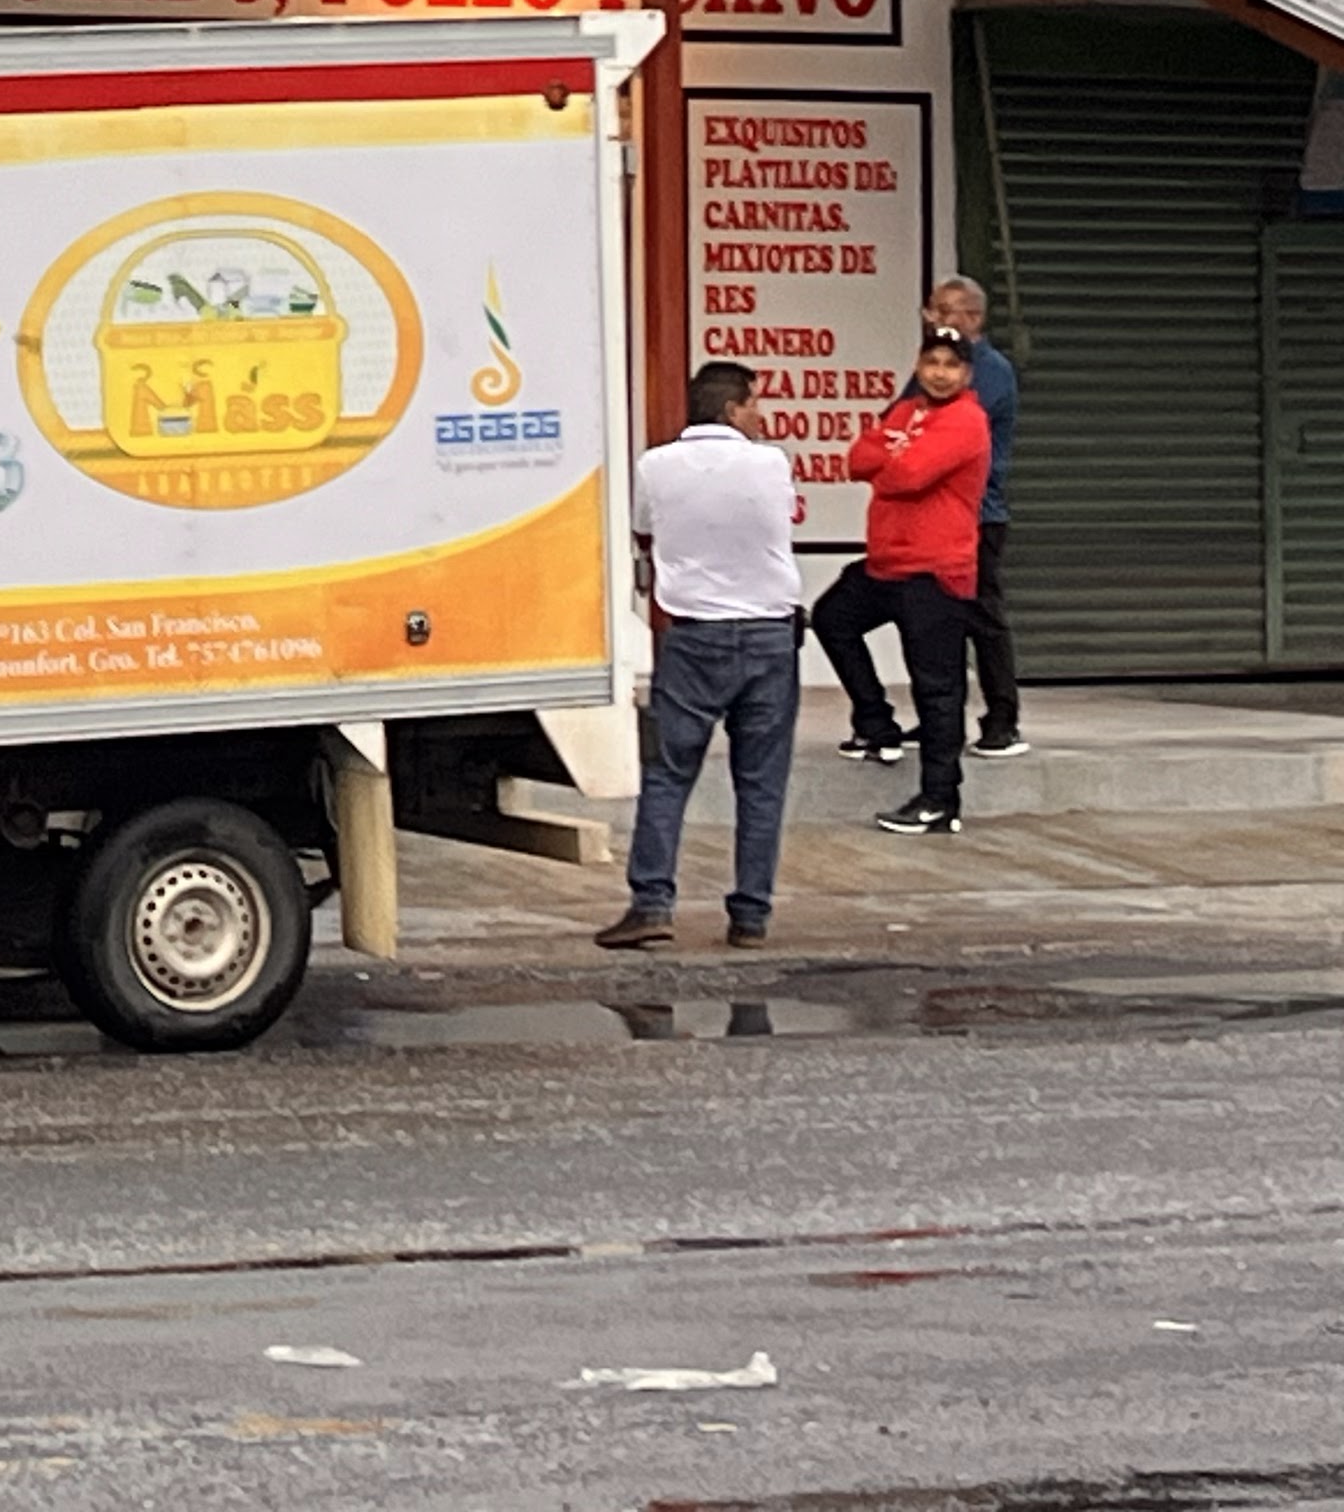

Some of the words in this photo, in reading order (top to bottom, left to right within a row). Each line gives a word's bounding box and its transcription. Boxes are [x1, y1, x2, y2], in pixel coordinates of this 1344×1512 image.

[703, 115, 867, 153] EXQUISITOS
[703, 159, 848, 190] PLATILLOS
[854, 160, 897, 191] DE:
[702, 201, 849, 232] CARNITAS.
[703, 243, 833, 274] MIXIOTES
[839, 244, 876, 275] DE
[703, 285, 756, 315] RES
[703, 328, 835, 357] CARNERO
[802, 370, 837, 400] DE
[844, 370, 895, 400] RES
[817, 412, 854, 440] DE
[106, 614, 146, 638] San
